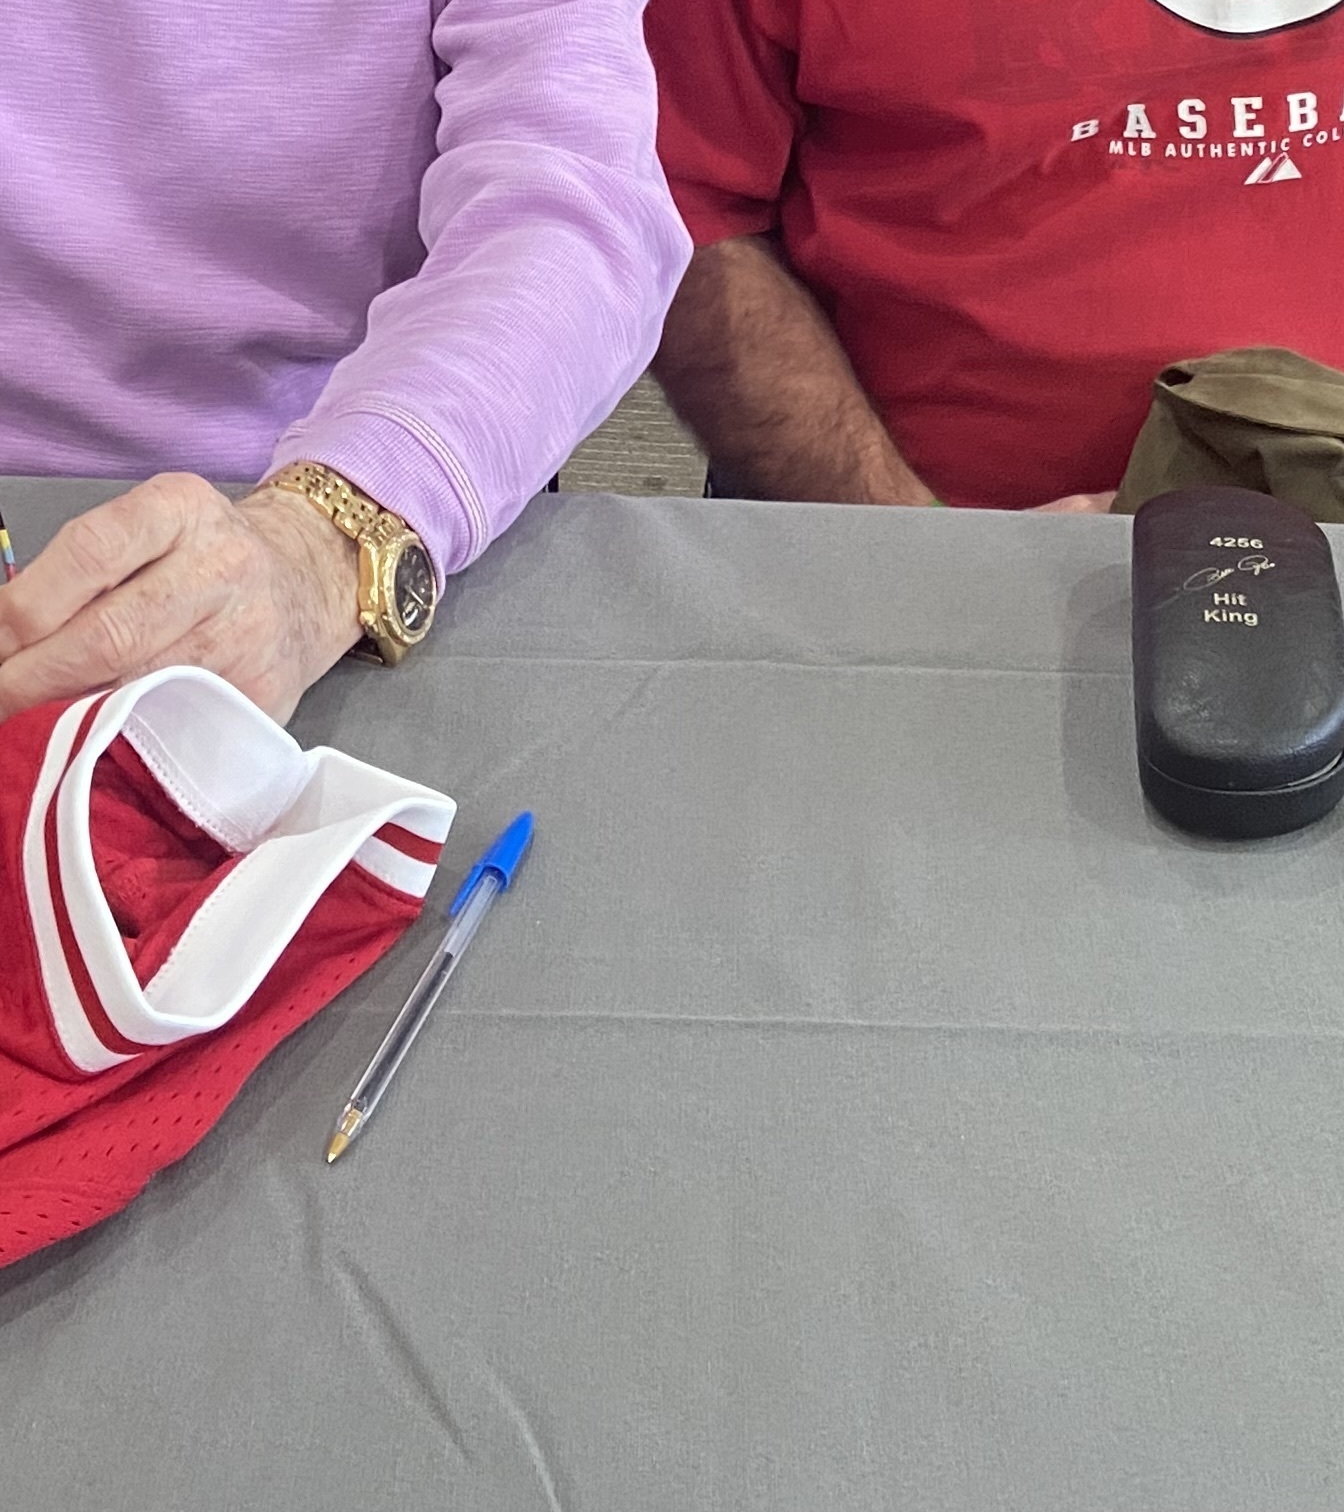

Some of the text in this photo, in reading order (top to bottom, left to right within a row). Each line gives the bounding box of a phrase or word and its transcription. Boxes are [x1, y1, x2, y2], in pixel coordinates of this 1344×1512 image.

[1109, 139, 1152, 157] MLB
[1164, 137, 1291, 158] AUTHENTIC
[1209, 536, 1264, 549] 4256
[1213, 593, 1247, 606] Hit
[1204, 609, 1259, 626] King
